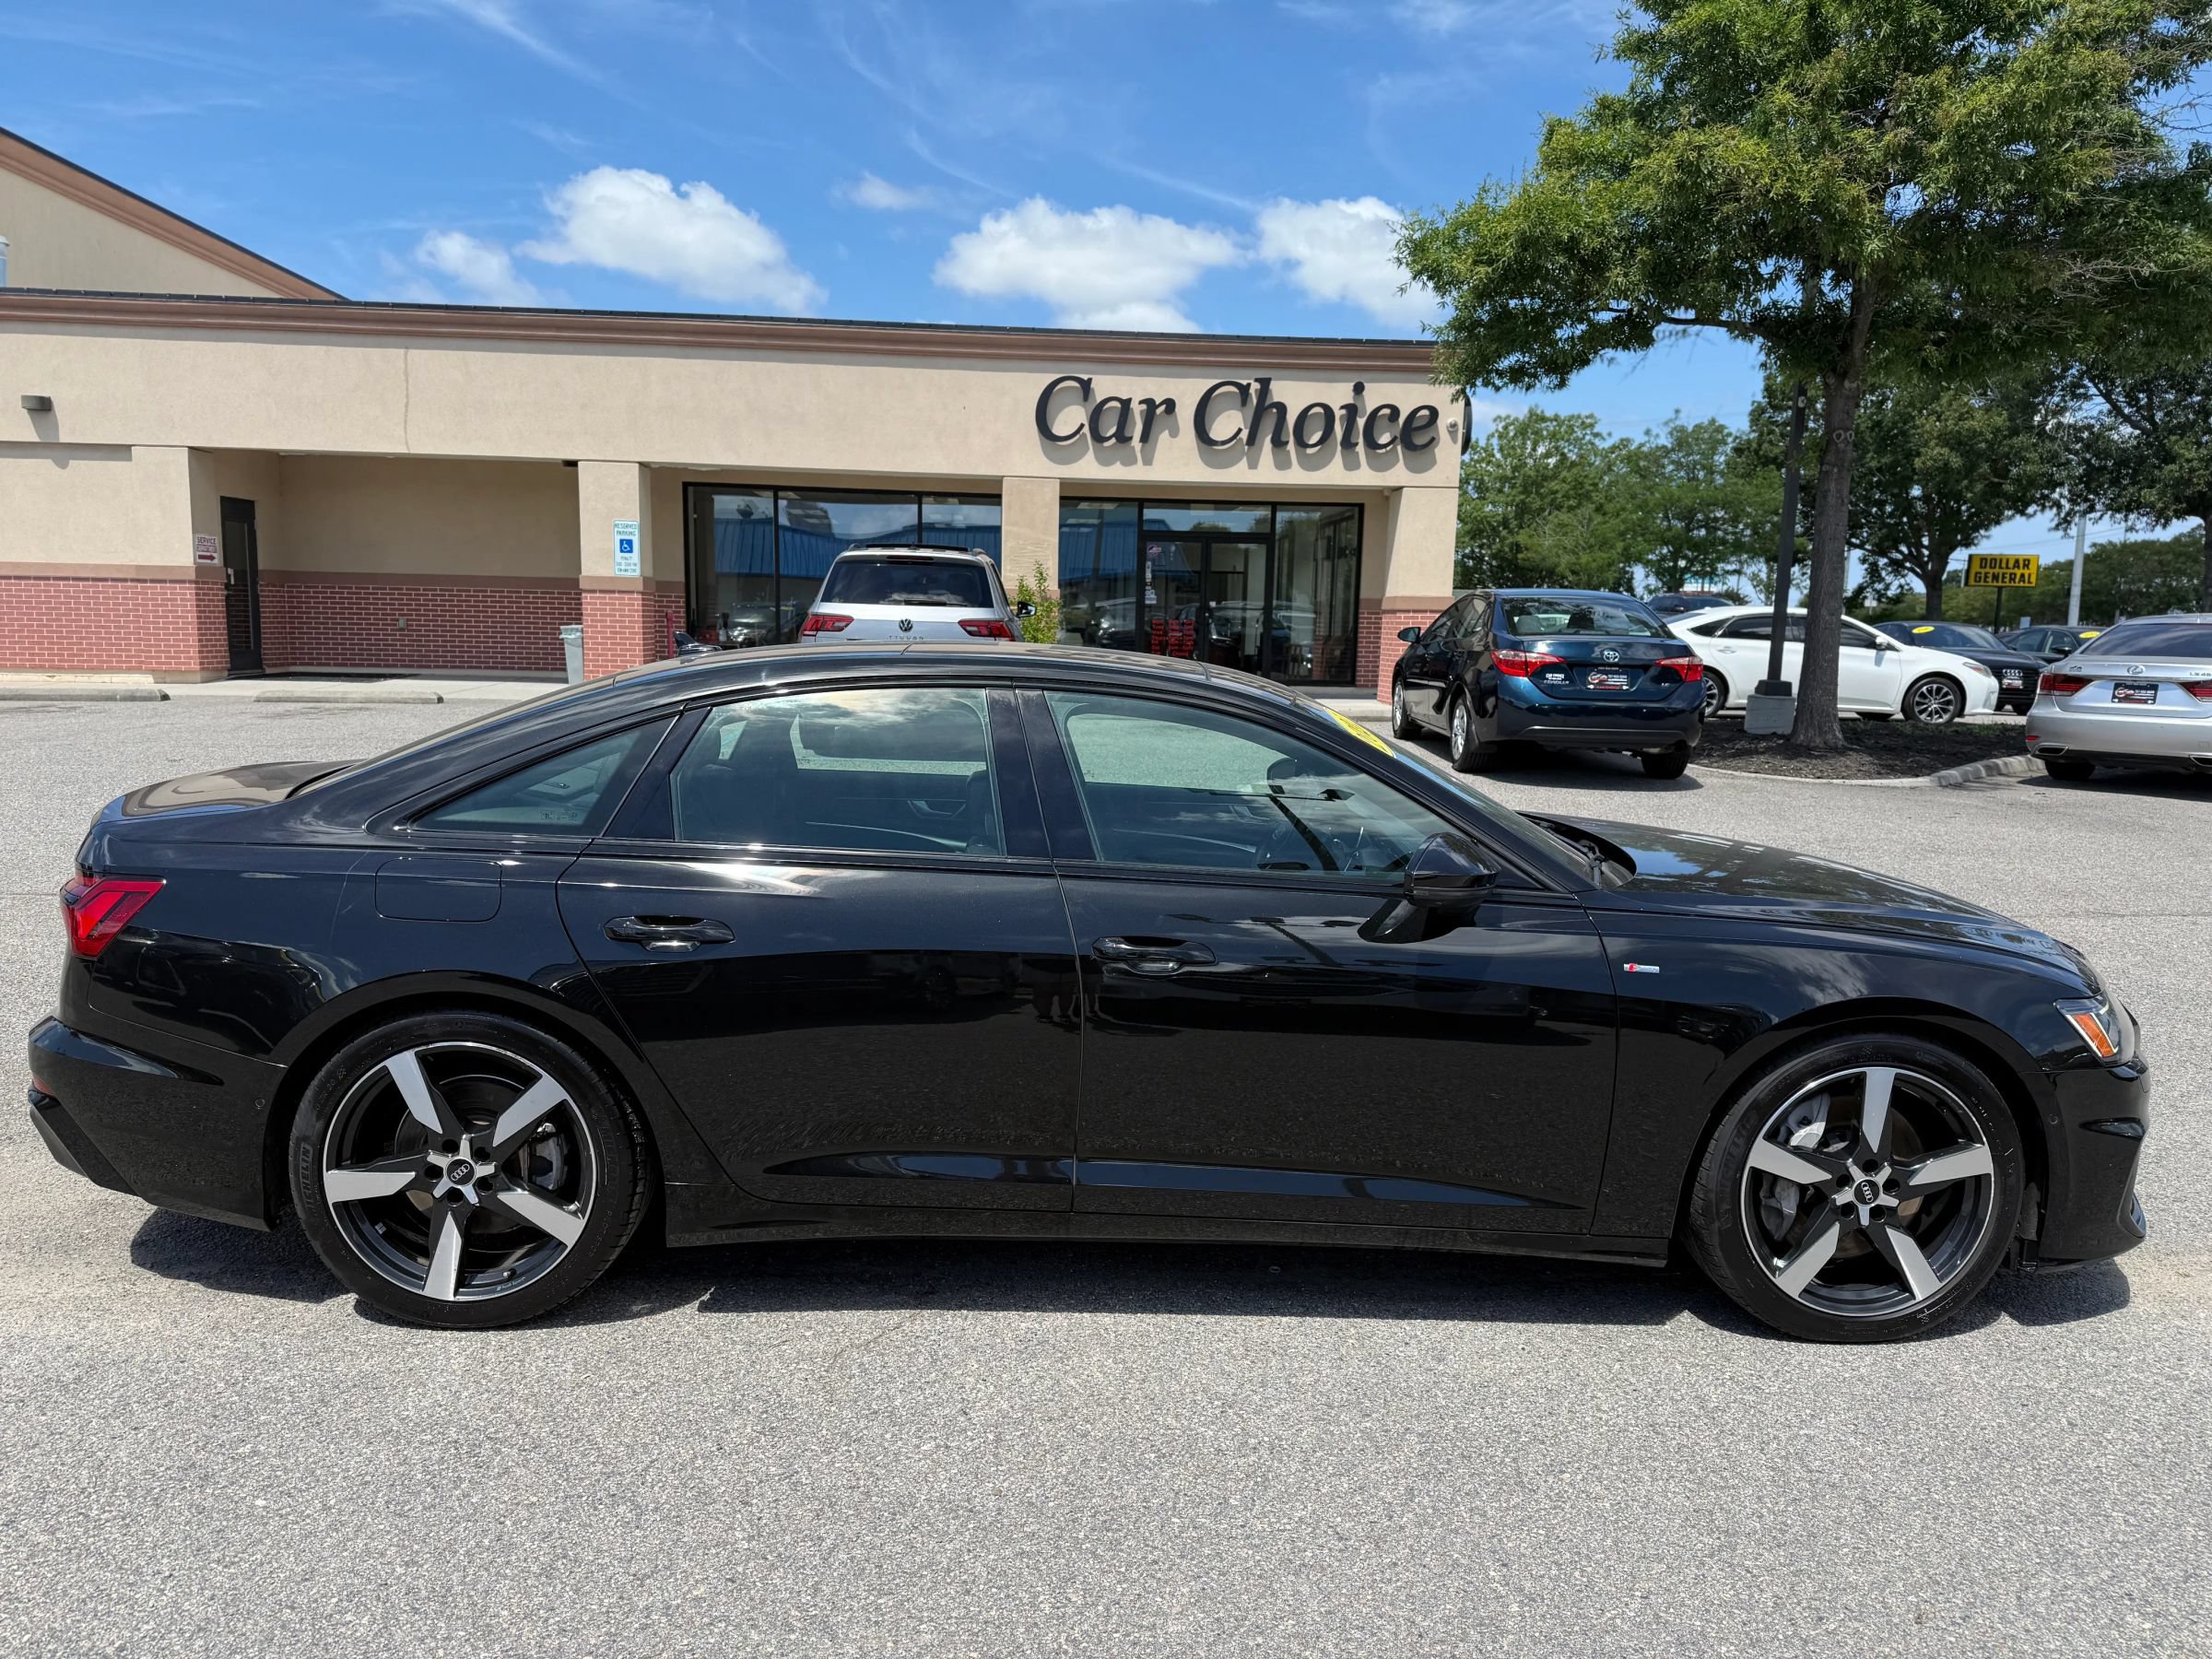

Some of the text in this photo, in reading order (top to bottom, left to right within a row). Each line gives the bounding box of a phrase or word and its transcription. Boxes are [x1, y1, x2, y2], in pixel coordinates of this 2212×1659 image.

[1035, 375, 1440, 452] Car Choice
[196, 536, 217, 545] SERVICE
[1979, 558, 2030, 570] DOLLAR
[1974, 571, 2033, 584] GENERAL
